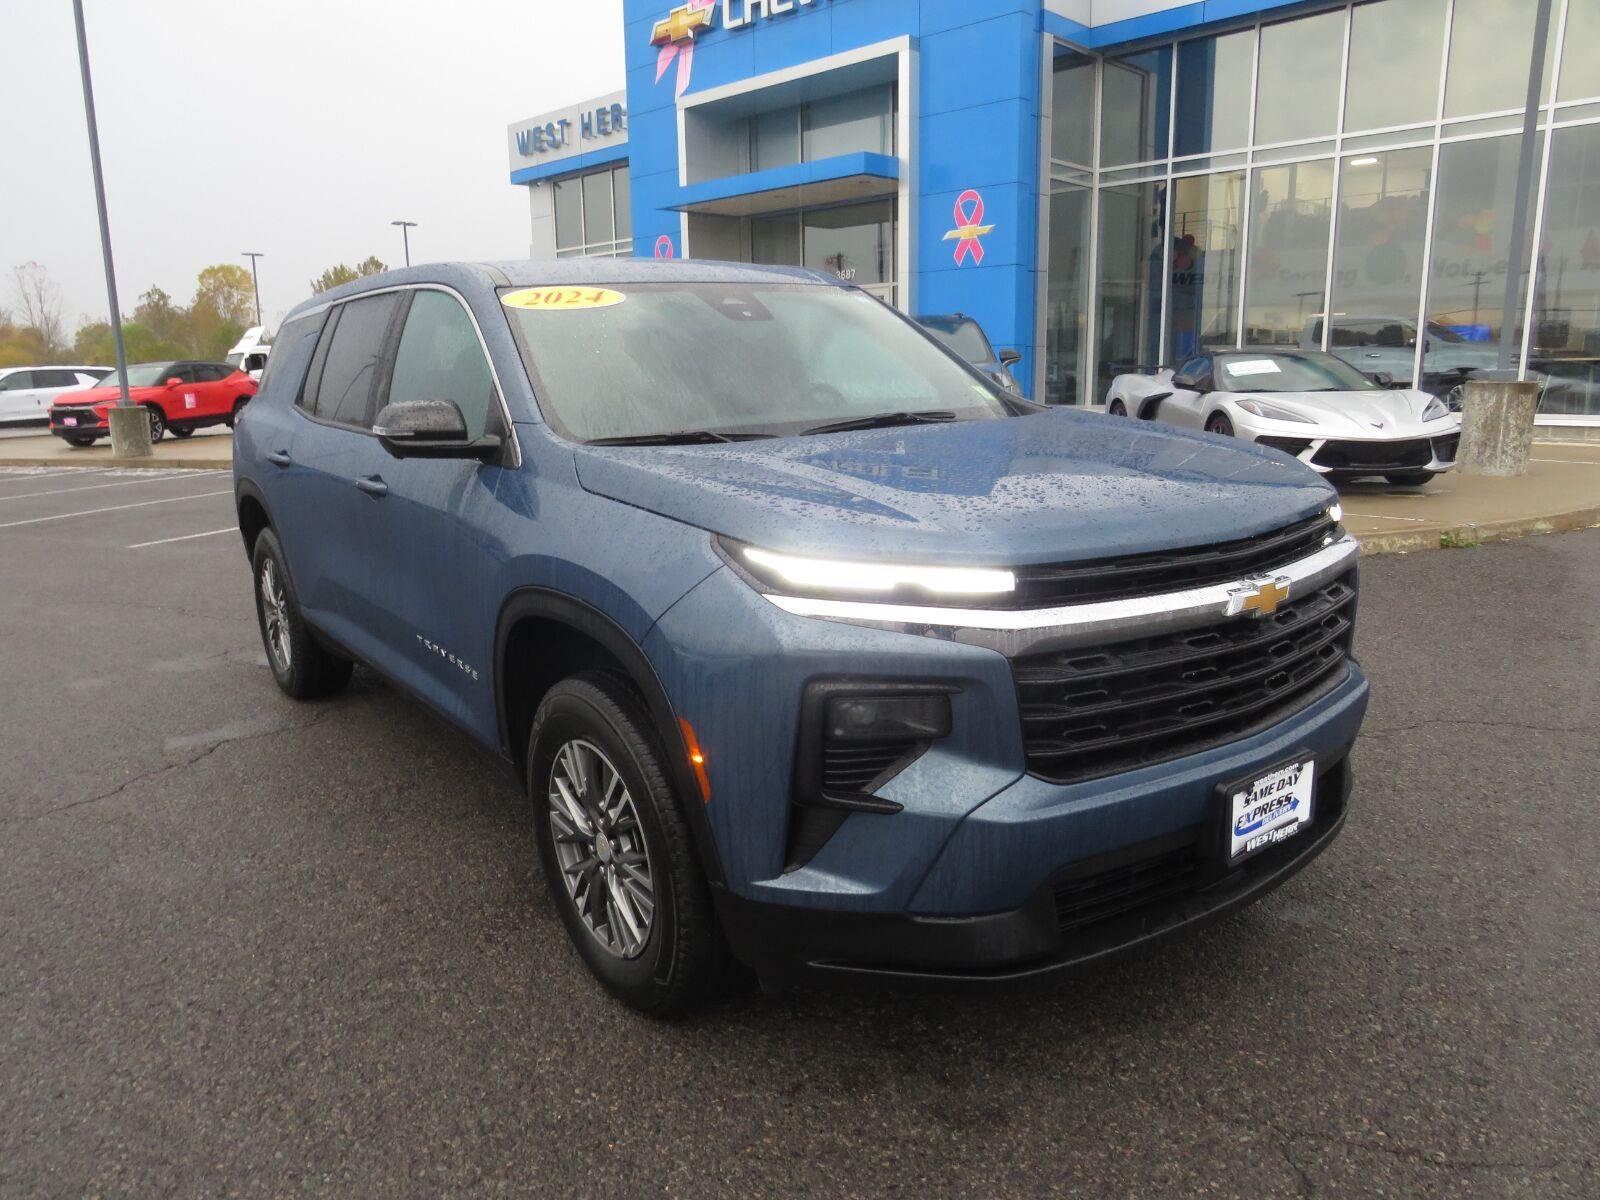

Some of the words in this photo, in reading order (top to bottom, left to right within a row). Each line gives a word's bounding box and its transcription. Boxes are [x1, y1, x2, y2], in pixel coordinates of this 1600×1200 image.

[516, 118, 569, 156] WEST
[523, 290, 605, 306] 2024
[1243, 782, 1276, 809] SAME
[1276, 773, 1300, 792] DAY
[1237, 792, 1294, 829] EXPRESS
